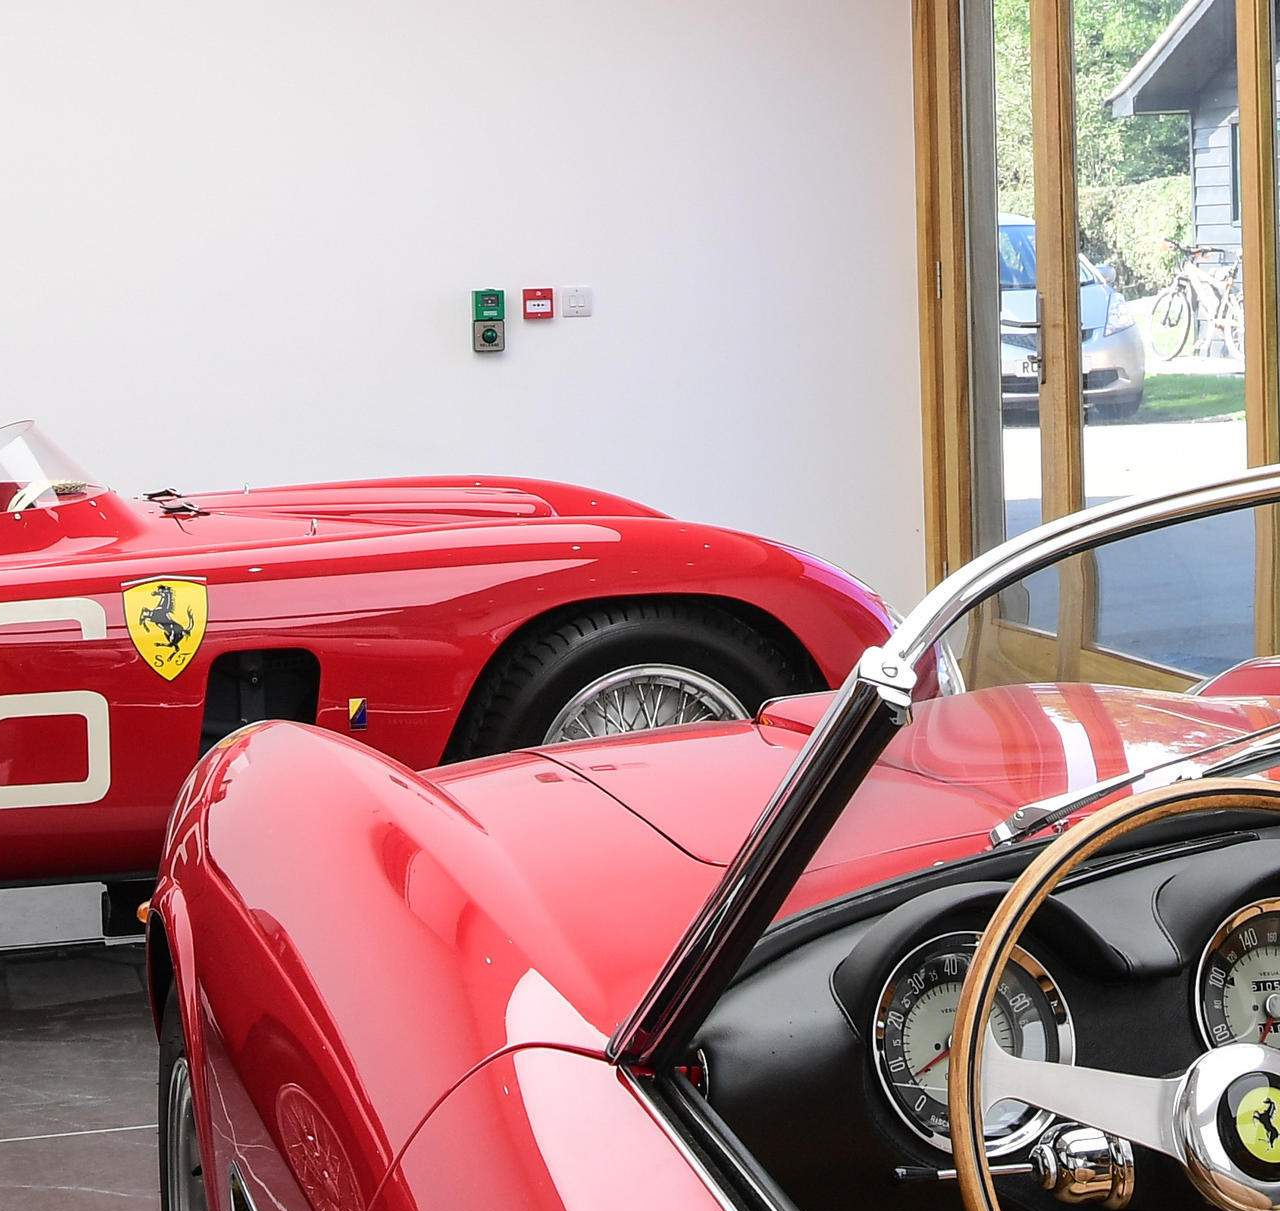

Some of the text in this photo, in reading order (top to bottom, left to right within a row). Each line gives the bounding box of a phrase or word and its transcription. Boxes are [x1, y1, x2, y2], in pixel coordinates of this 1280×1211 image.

[1239, 927, 1258, 951] 140
[943, 956, 958, 976] 40
[1226, 951, 1238, 964] 120
[907, 972, 926, 995] 30
[928, 969, 939, 982] 35
[1209, 966, 1226, 988] 100
[998, 982, 1010, 996] 55
[1009, 992, 1031, 1013] 60
[887, 1011, 904, 1031] 20
[1213, 1023, 1229, 1042] 60
[892, 1039, 902, 1047] 15
[889, 1056, 905, 1073] 10
[914, 1094, 927, 1112] 0
